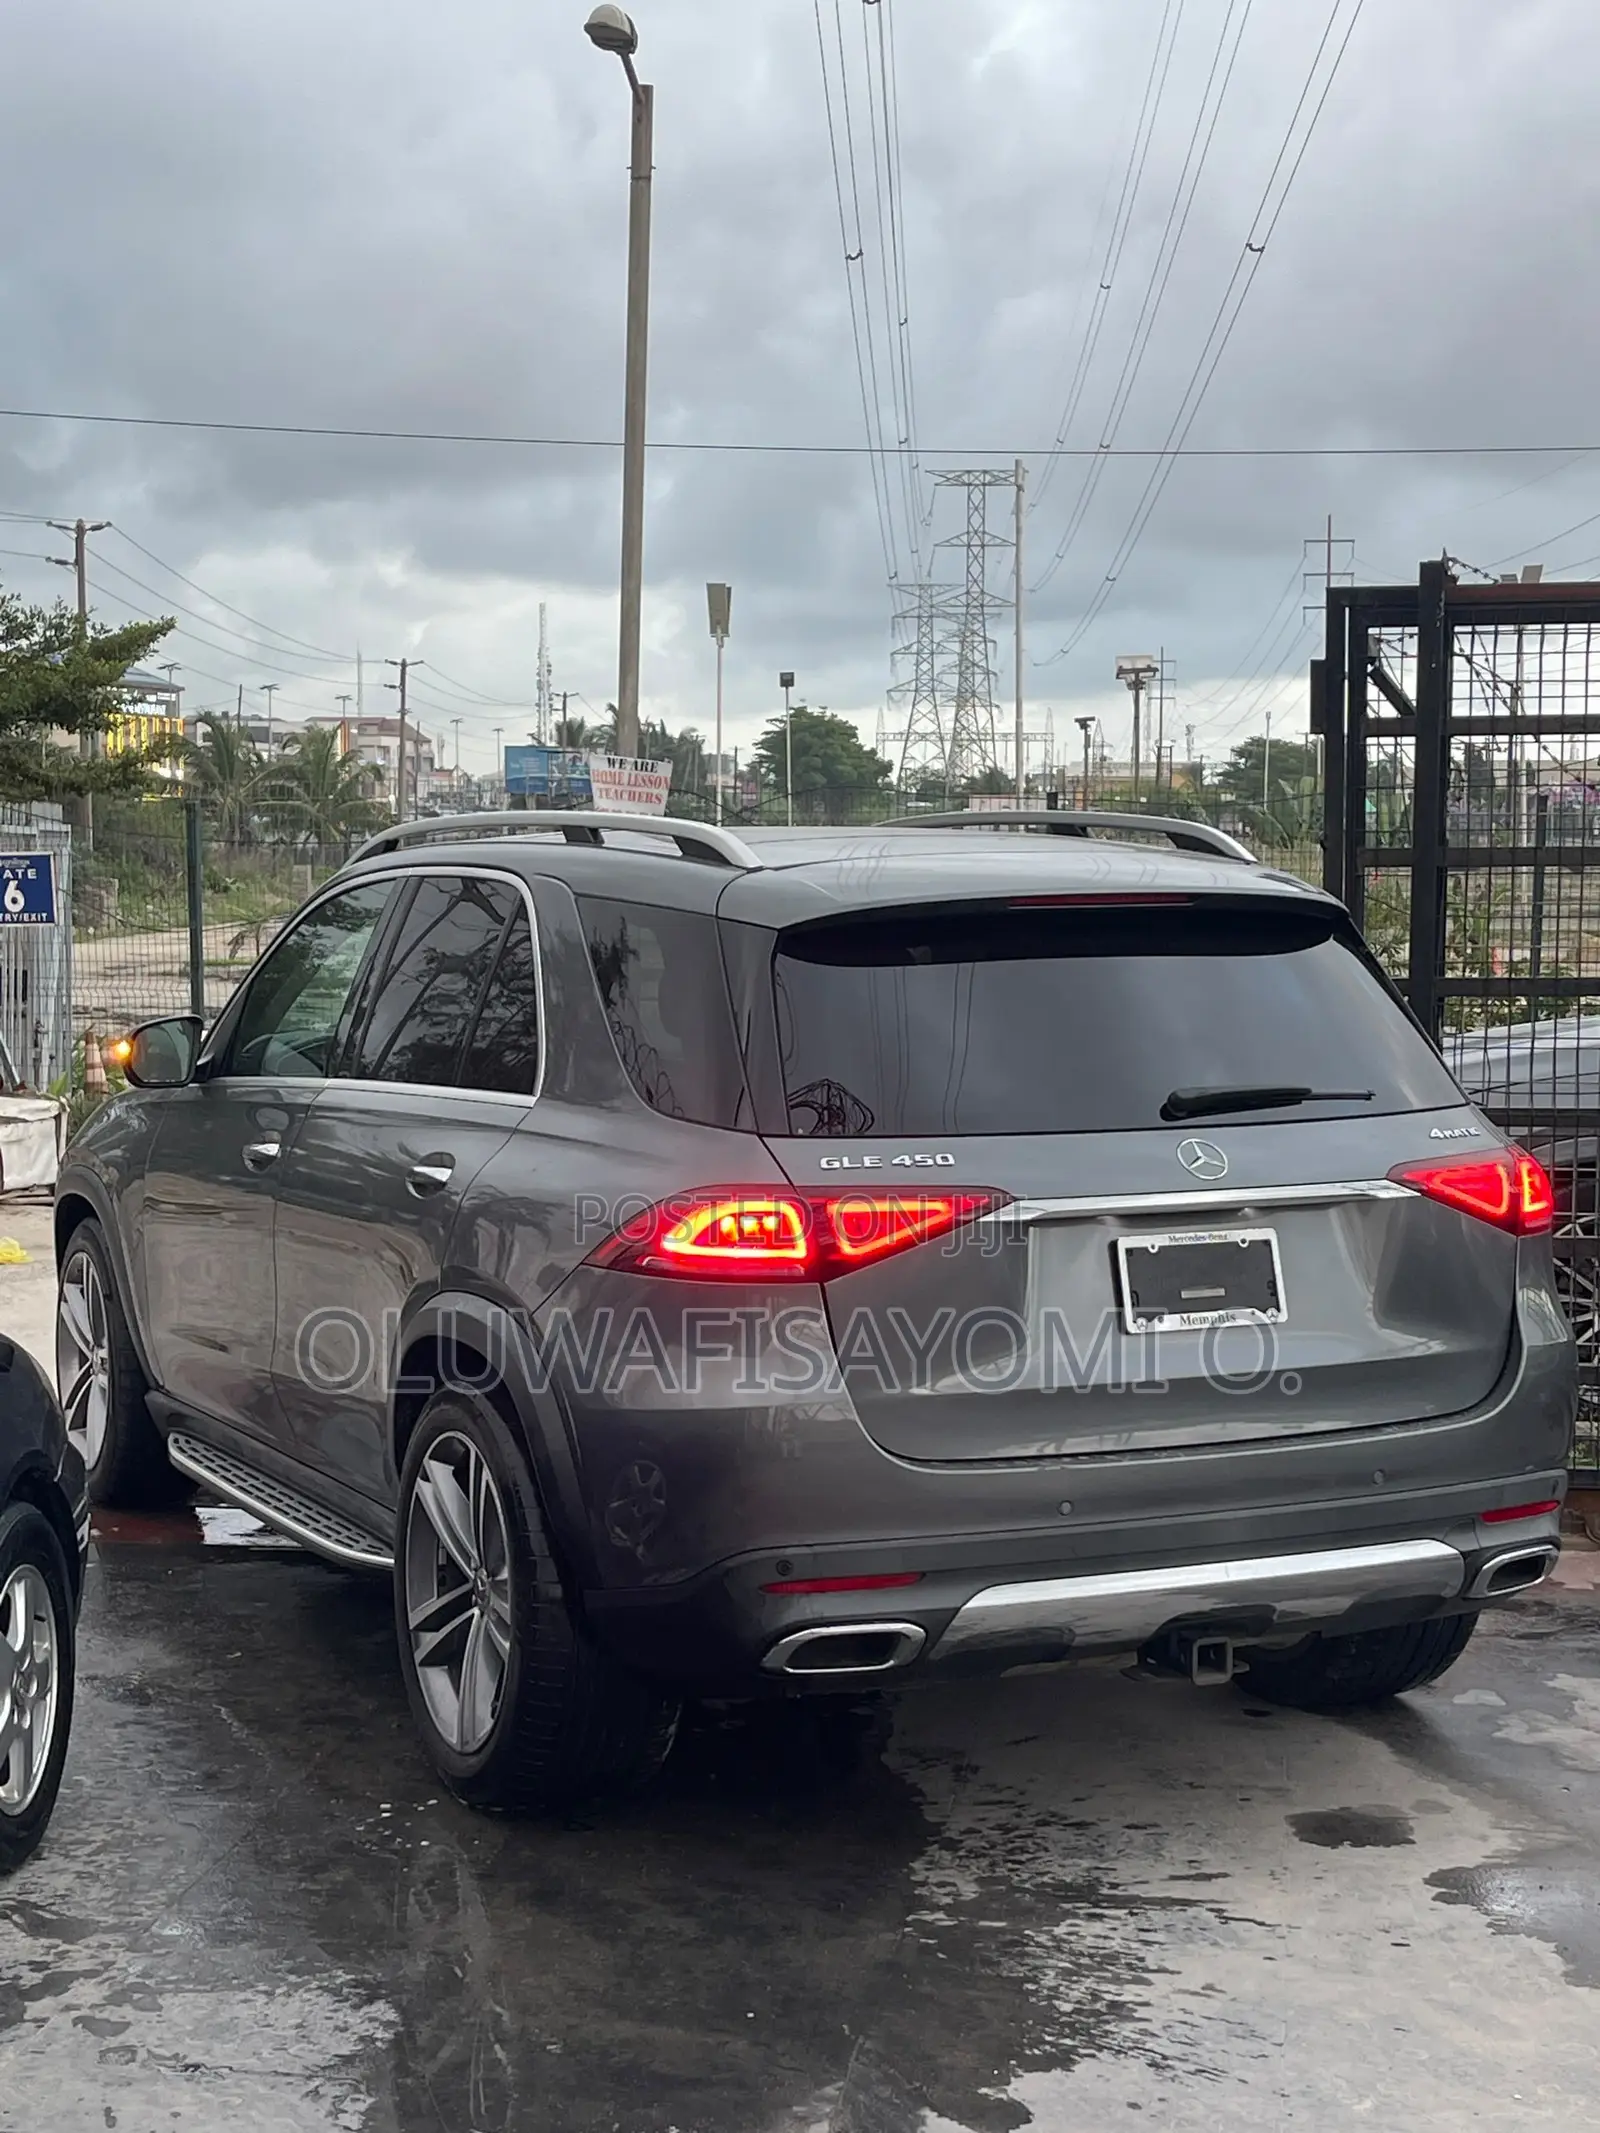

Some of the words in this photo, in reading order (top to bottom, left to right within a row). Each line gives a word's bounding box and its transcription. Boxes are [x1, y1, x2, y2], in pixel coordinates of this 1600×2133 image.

[607, 757, 627, 770] WE
[632, 759, 659, 773] ARE
[592, 769, 625, 786] HOME
[627, 772, 672, 790] LESSON
[597, 787, 664, 805] TEACHERS
[0, 868, 37, 879] ATE
[4, 880, 25, 913] 6
[820, 1156, 883, 1170] GLE
[892, 1153, 955, 1168] 450
[1180, 1312, 1237, 1327] Memphis
